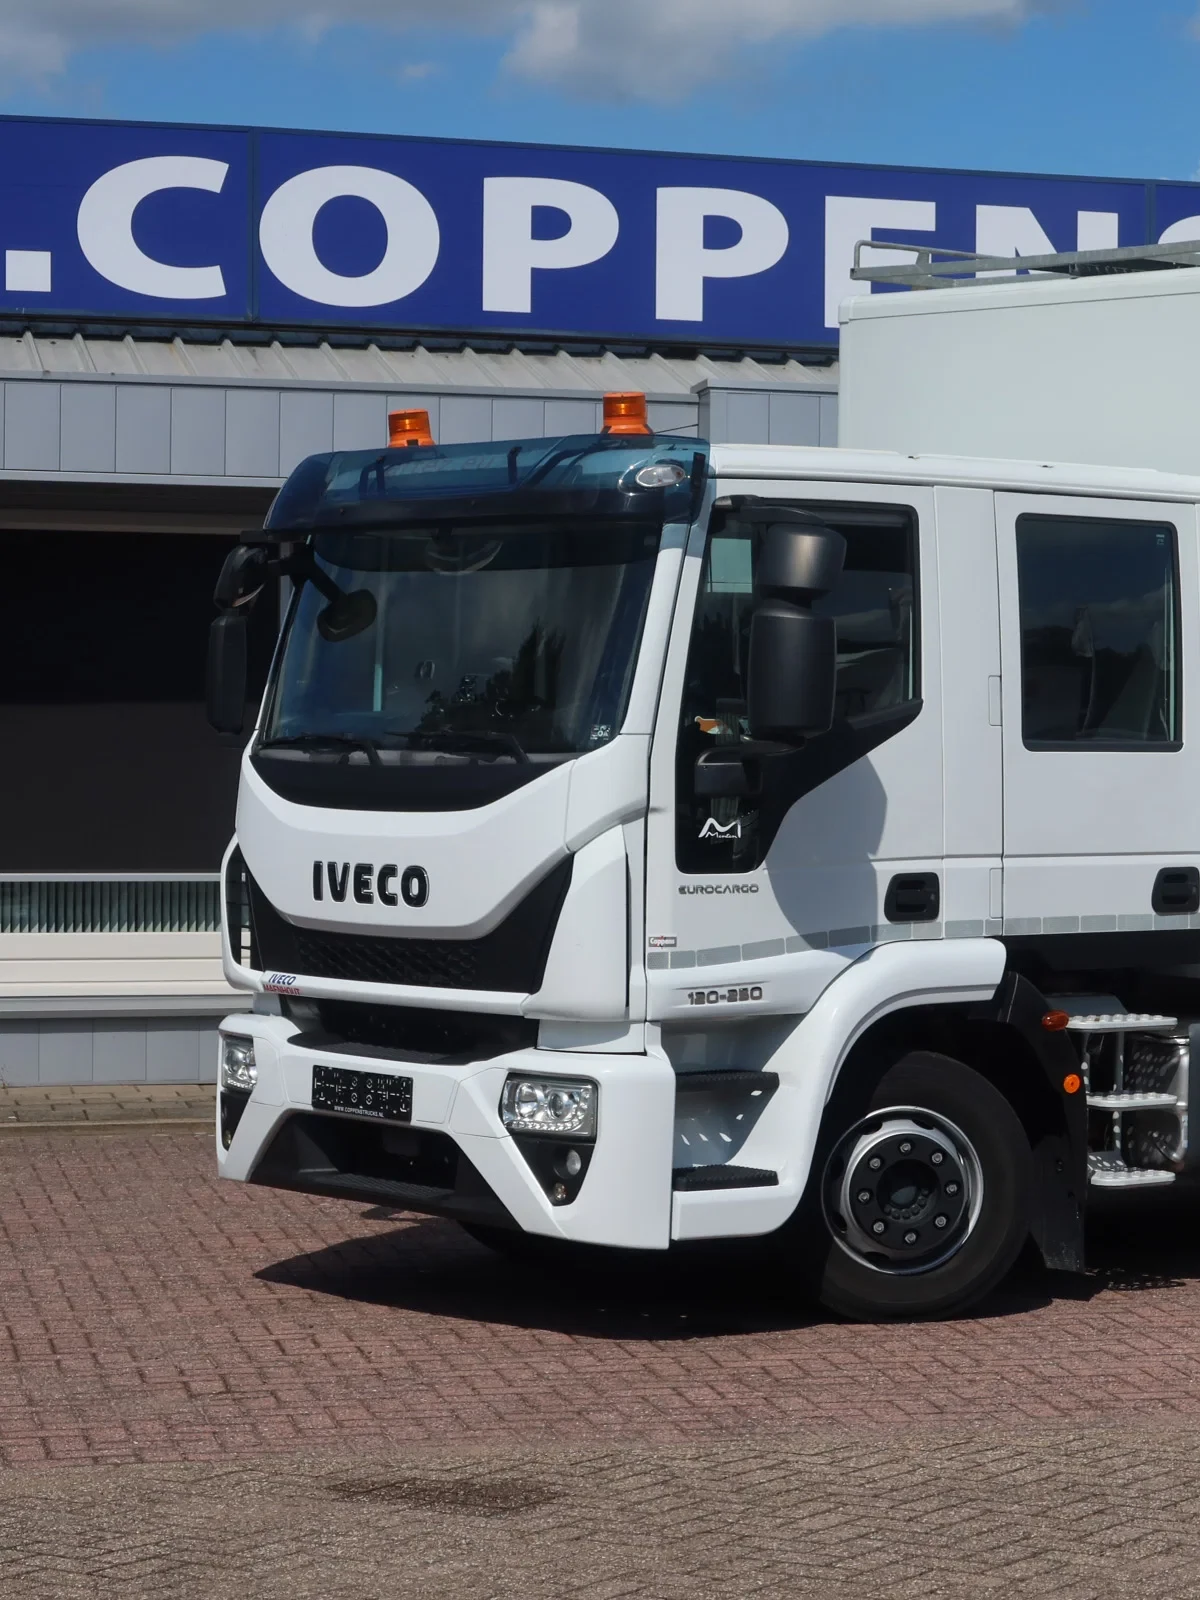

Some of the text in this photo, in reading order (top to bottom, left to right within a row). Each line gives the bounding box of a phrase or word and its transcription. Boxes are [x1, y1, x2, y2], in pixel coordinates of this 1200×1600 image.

[312, 860, 430, 908] IVECO
[678, 884, 759, 895] EUROCARGO
[269, 973, 297, 986] IVECO
[688, 986, 763, 1005] 120-250
